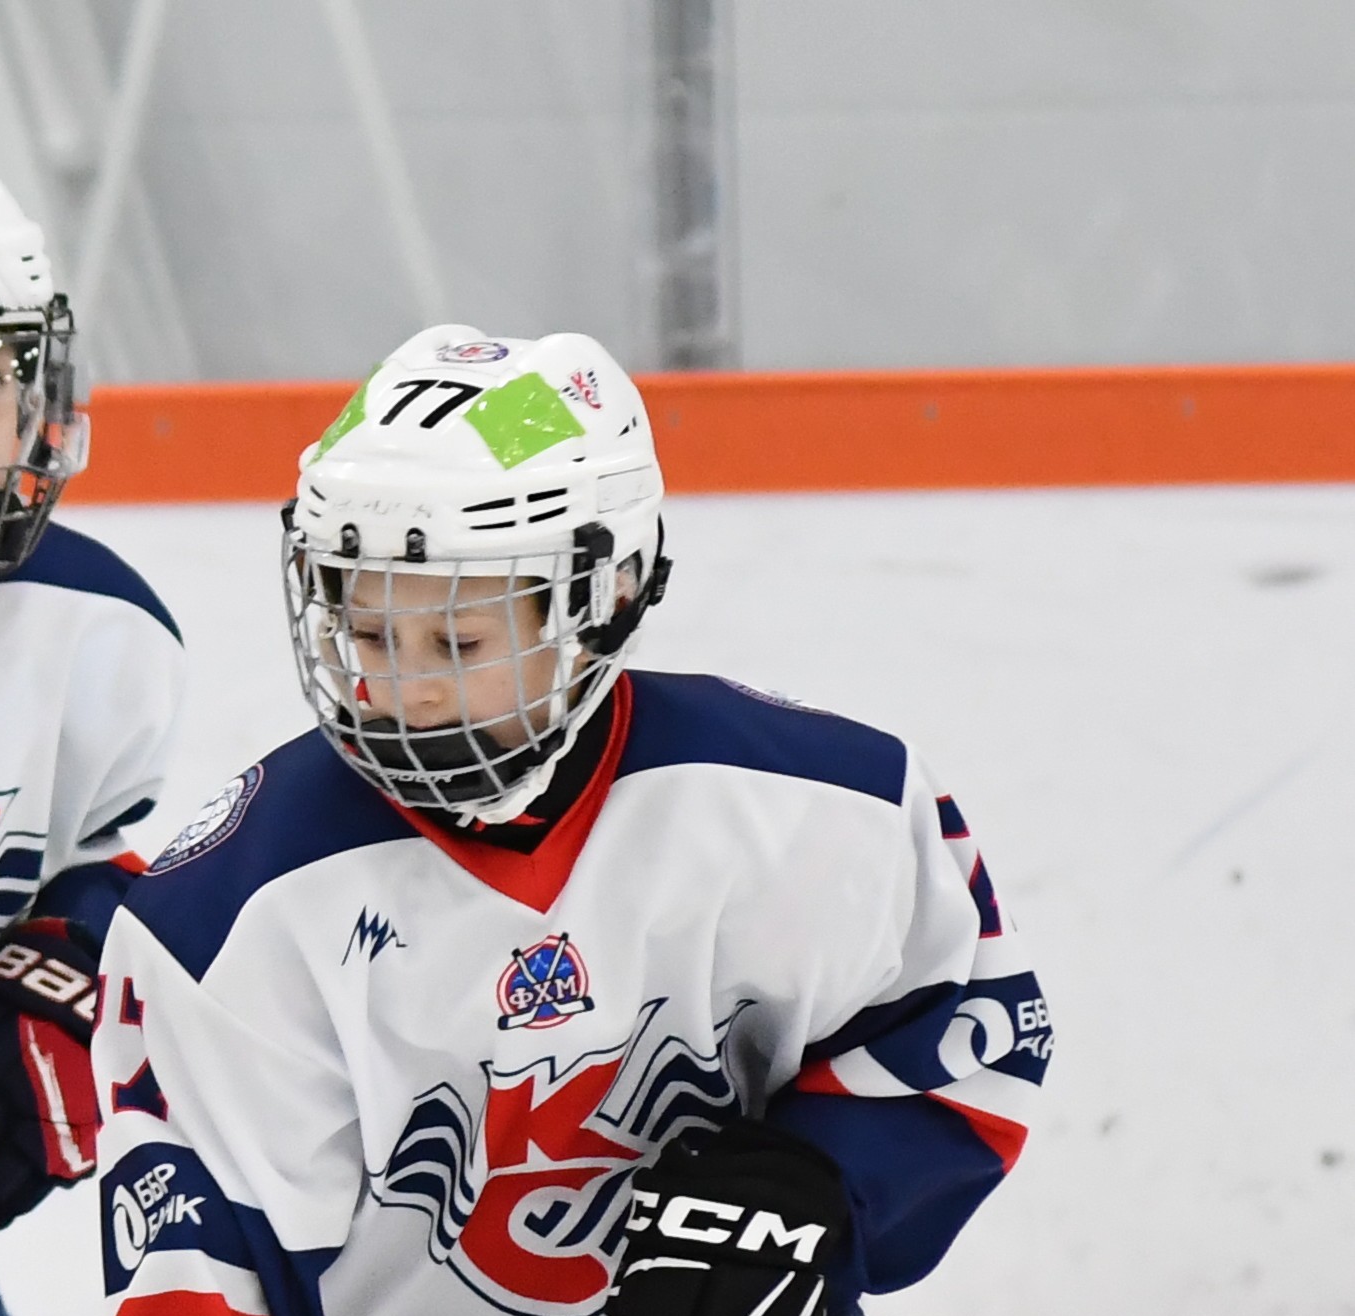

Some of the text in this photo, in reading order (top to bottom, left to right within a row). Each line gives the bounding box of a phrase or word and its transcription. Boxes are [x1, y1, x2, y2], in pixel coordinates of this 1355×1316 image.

[379, 379, 484, 429] 77
[509, 974, 578, 1009] ФХМ
[625, 1189, 827, 1263] CCM
